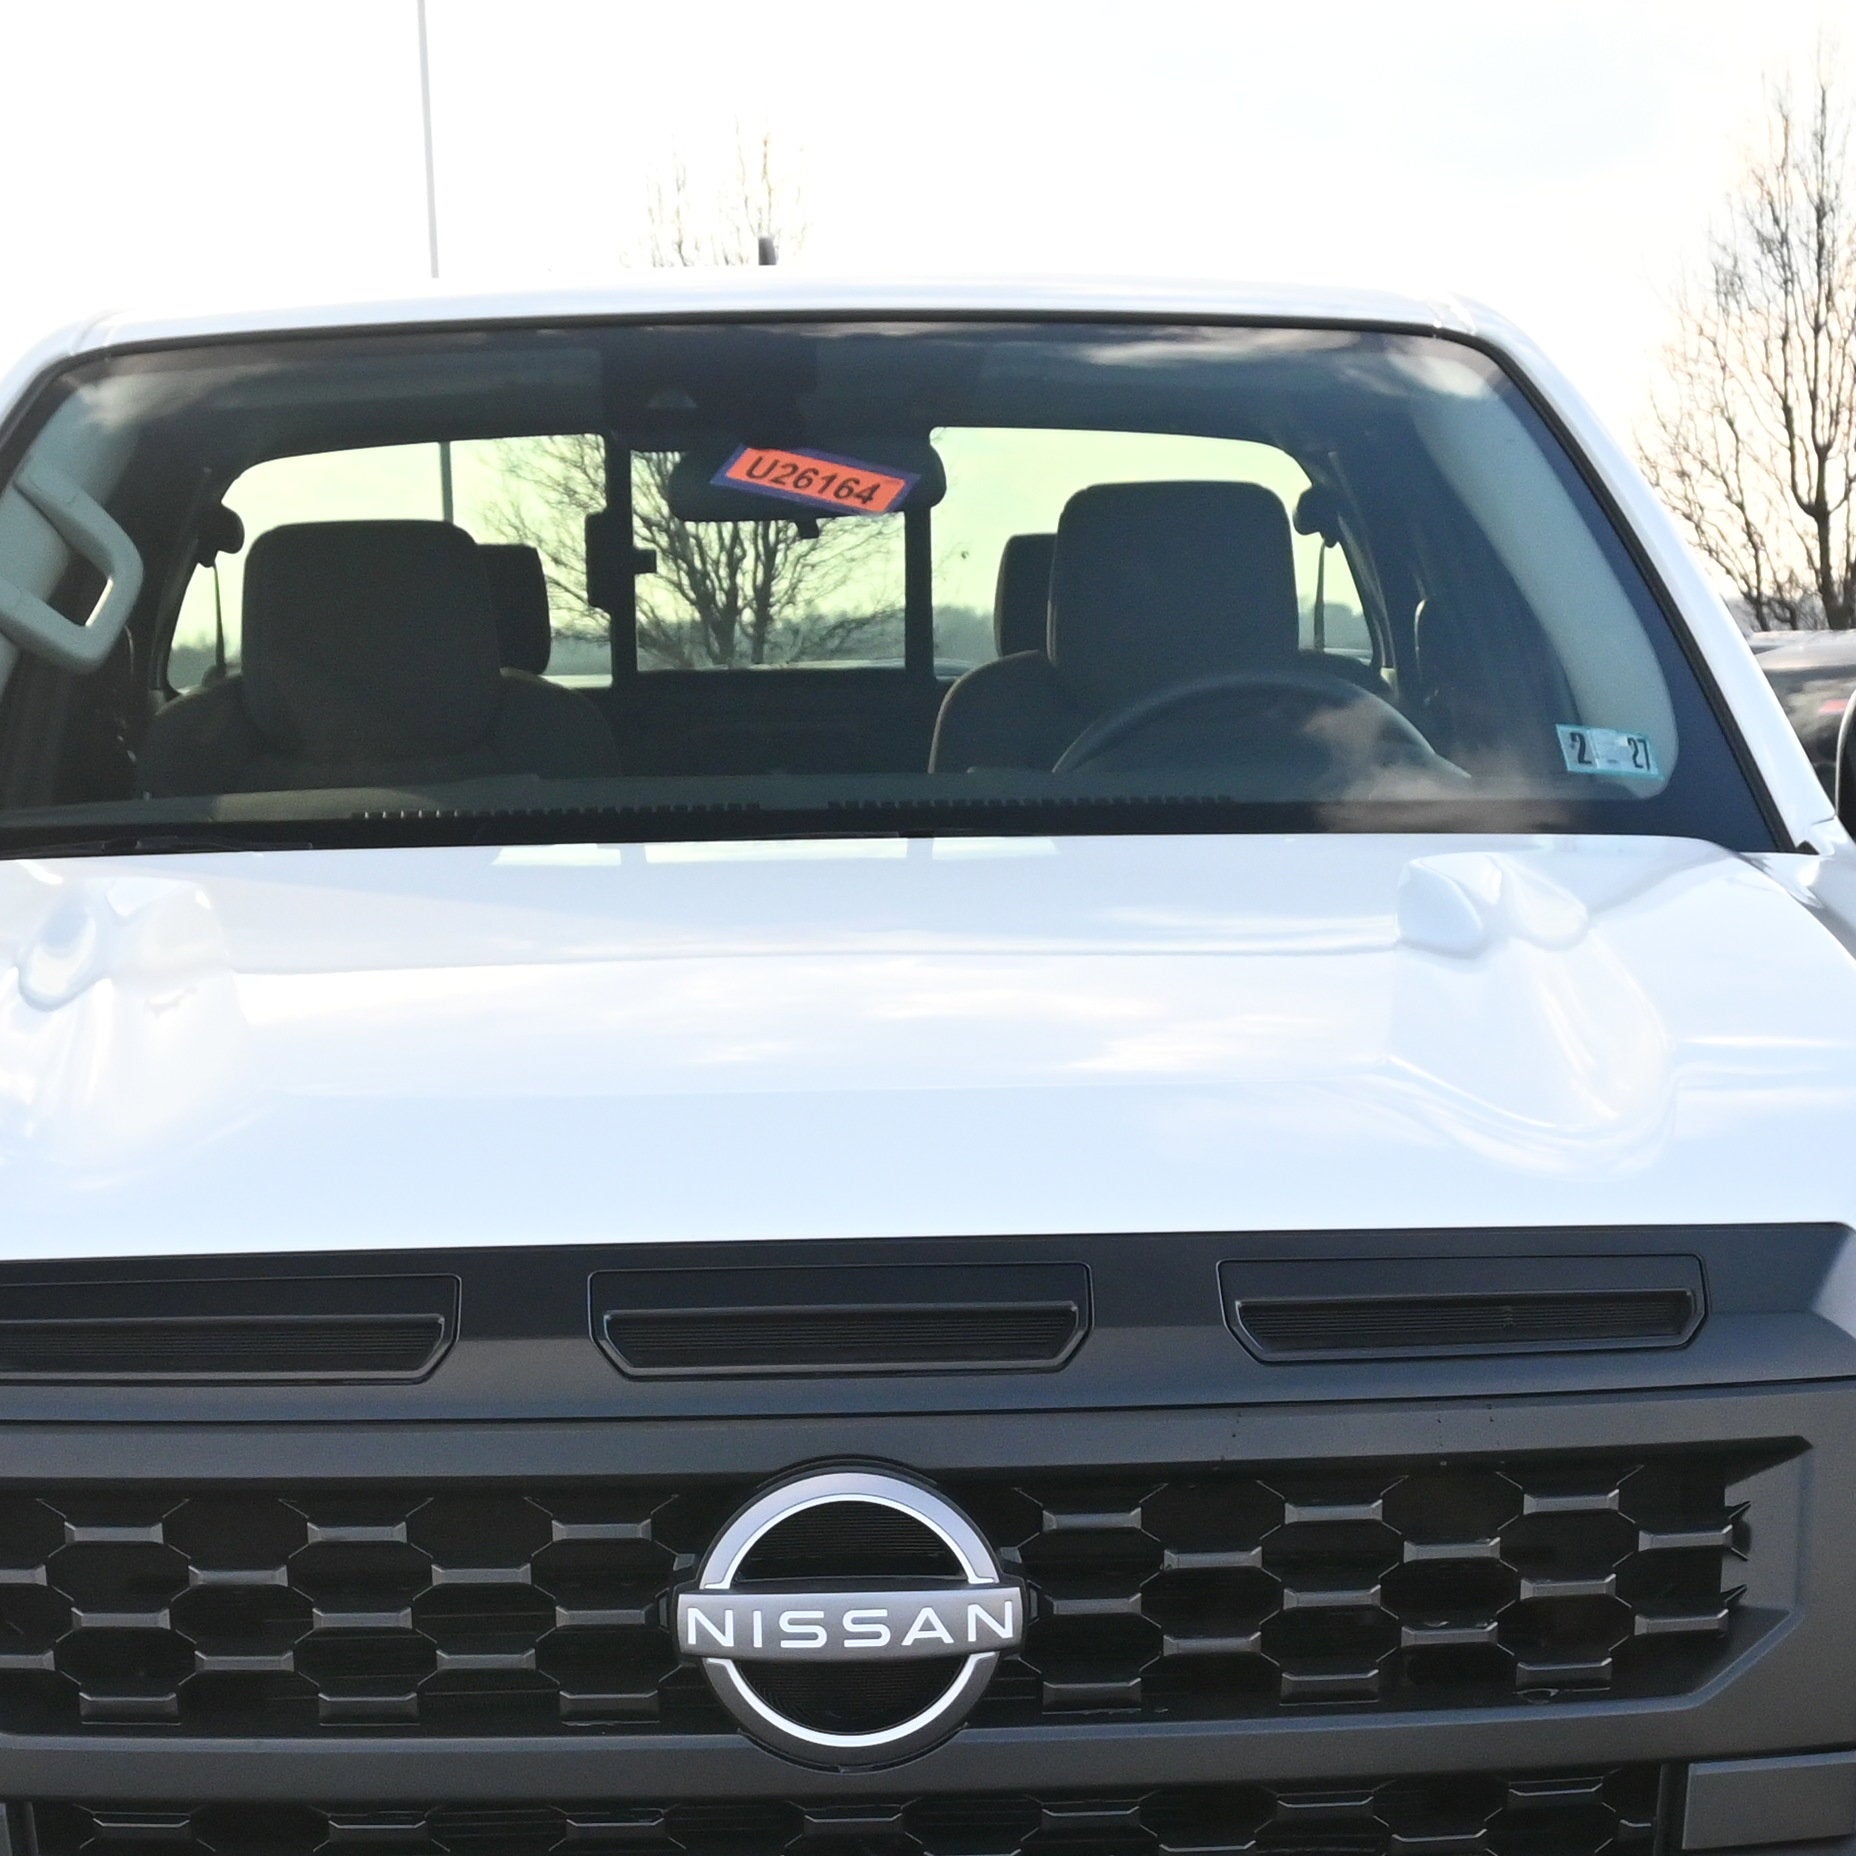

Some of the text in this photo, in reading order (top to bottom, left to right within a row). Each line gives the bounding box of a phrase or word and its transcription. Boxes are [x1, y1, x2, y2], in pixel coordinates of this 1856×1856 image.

[745, 454, 881, 505] U26164
[1569, 731, 1651, 772] 2 27
[687, 1600, 1014, 1649] NISSAN
